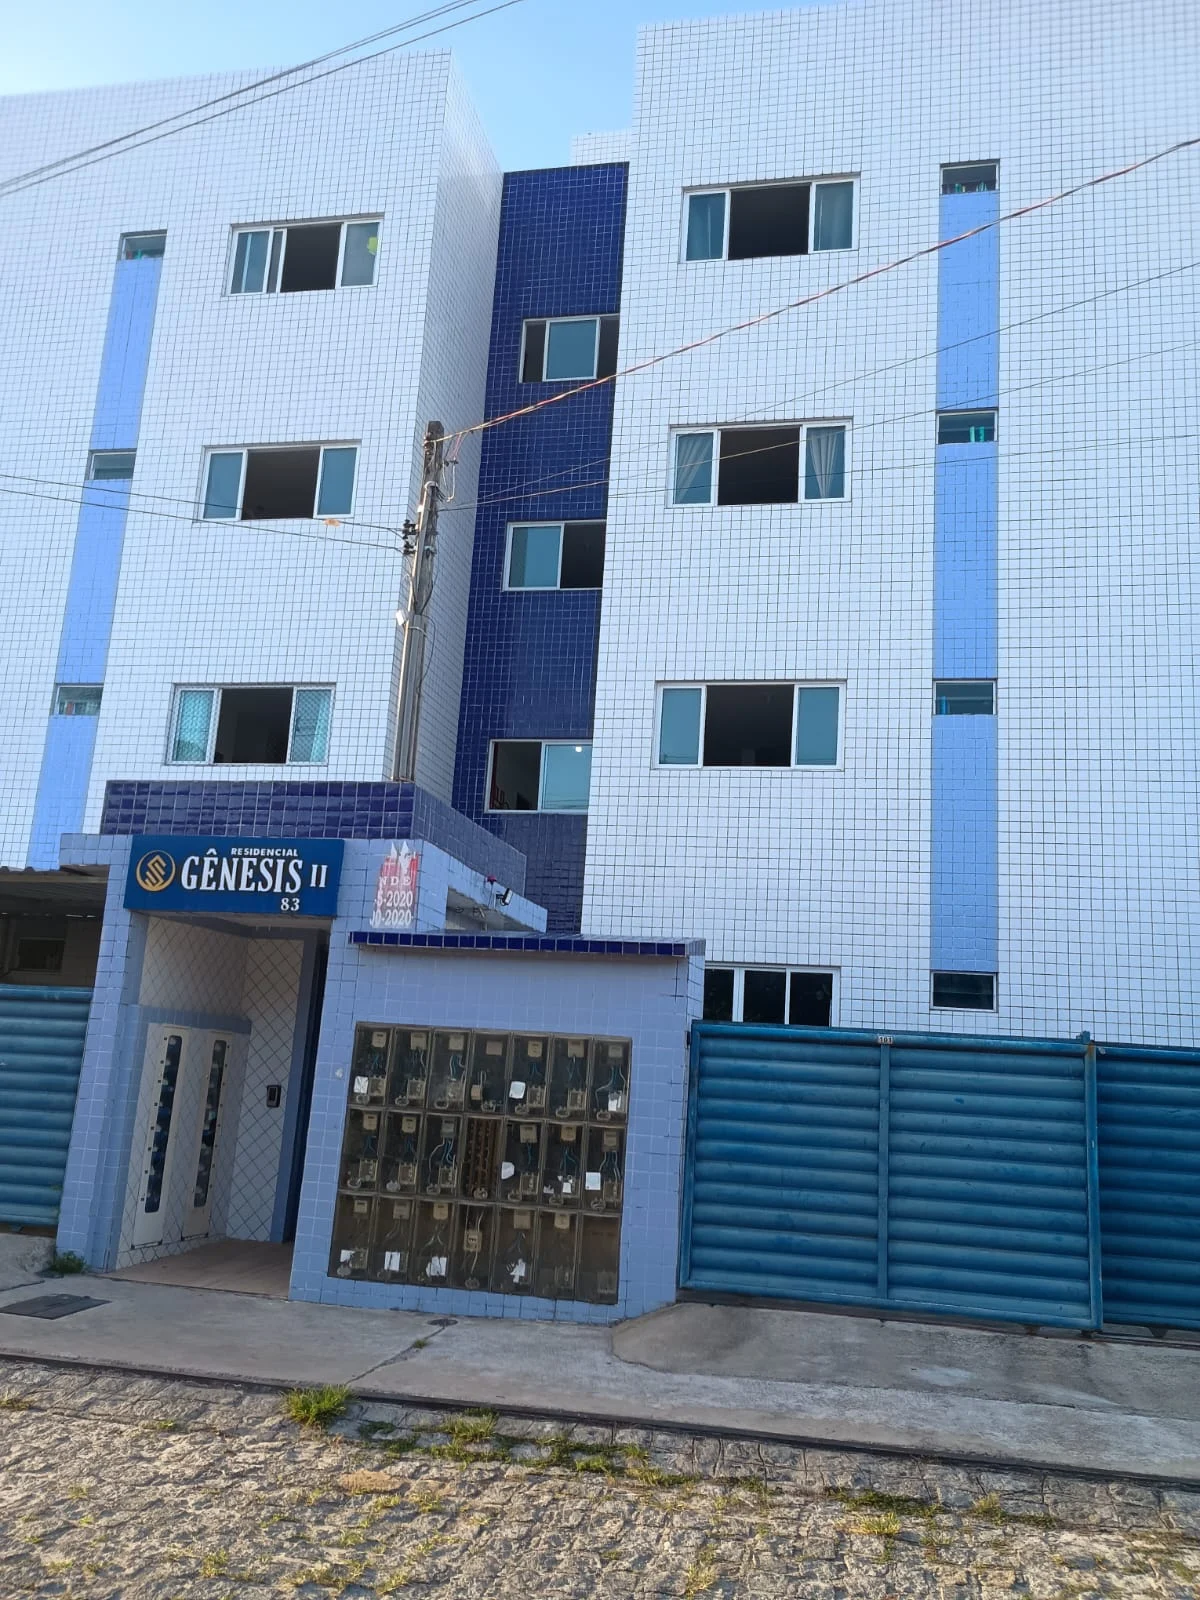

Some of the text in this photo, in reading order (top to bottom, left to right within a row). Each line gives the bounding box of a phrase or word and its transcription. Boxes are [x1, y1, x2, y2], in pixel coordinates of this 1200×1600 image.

[231, 847, 299, 857] RESIDENCIAL
[180, 848, 304, 894] GÊNESIS
[280, 897, 301, 911] 83
